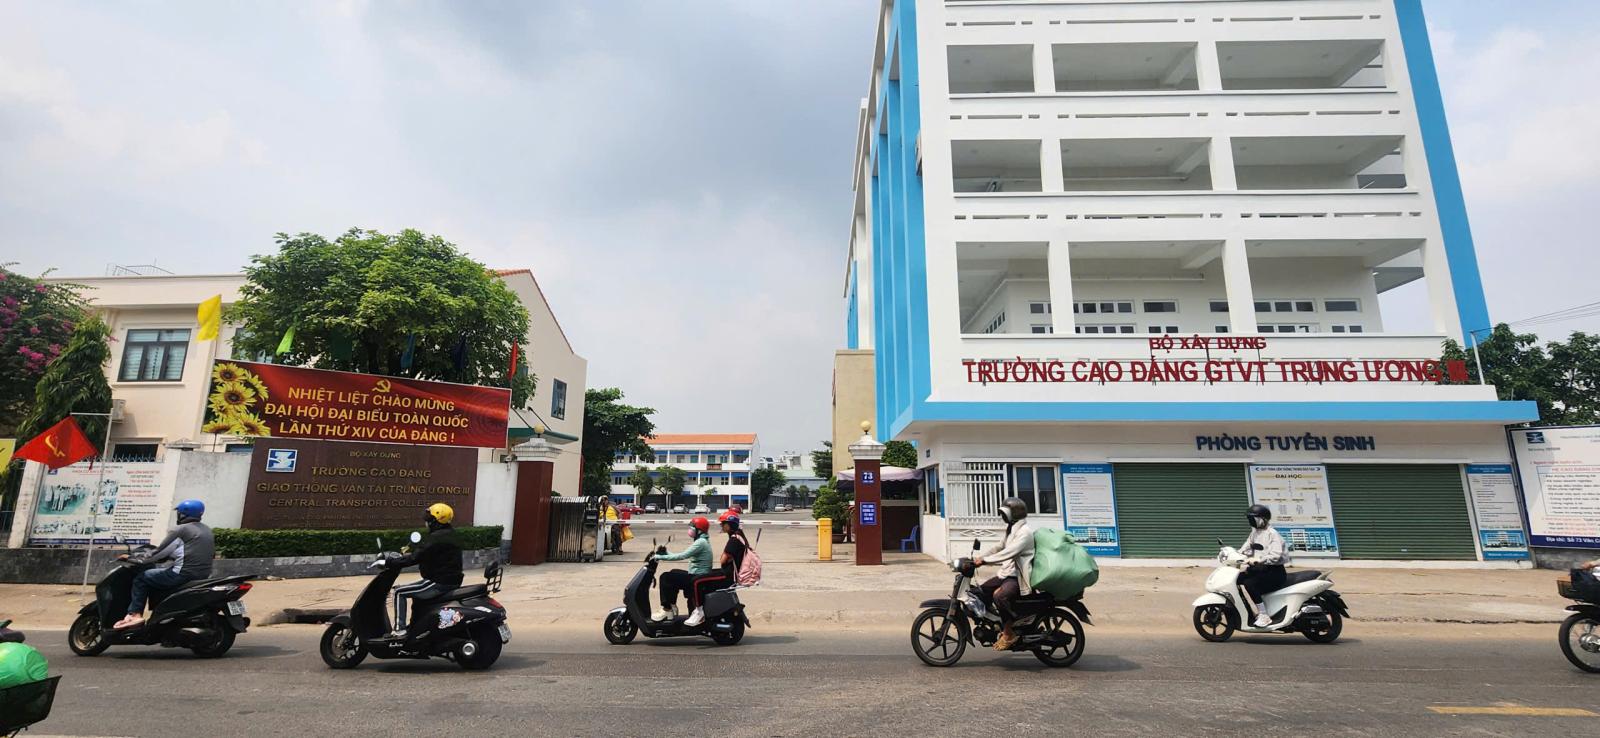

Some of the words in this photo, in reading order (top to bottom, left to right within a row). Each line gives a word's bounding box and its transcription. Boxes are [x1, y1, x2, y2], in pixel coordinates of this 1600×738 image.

[1149, 334, 1174, 353] BỘ
[1180, 334, 1210, 350] XÂY
[1217, 337, 1266, 353] DỰNG
[962, 356, 1066, 382] TRƯỜNG
[1072, 360, 1122, 382] CAO
[1204, 360, 1268, 382] GTVT
[1275, 360, 1358, 382] TRUNG
[1363, 360, 1441, 382] ƯƠNG
[288, 387, 335, 404] NHIỆT
[339, 390, 370, 406] LIỆT
[373, 393, 412, 409] CHÀO
[415, 397, 455, 412] MỪNG
[265, 403, 292, 418] ĐẠI
[296, 404, 324, 420] HỘI
[328, 408, 353, 422] ĐẠI
[357, 408, 390, 423] BIỂU
[393, 411, 430, 426] TOÀN
[432, 413, 469, 428] QUỐC
[279, 419, 312, 436] LẦN
[316, 423, 350, 438] THỨ
[352, 427, 376, 439] XIV
[380, 426, 407, 440] CỦA
[411, 428, 448, 442] ĐẢNG
[450, 432, 455, 443] !
[1196, 432, 1263, 452] PHÒNG
[1265, 432, 1329, 452] TUYỂN
[1333, 435, 1375, 452] SINH
[370, 467, 396, 477] CAO
[863, 472, 873, 480] 73
[257, 482, 290, 493] GIAO
[389, 485, 426, 495] TRUNG
[269, 498, 321, 508] CENTRAL
[326, 499, 388, 508] TRANSPORT
